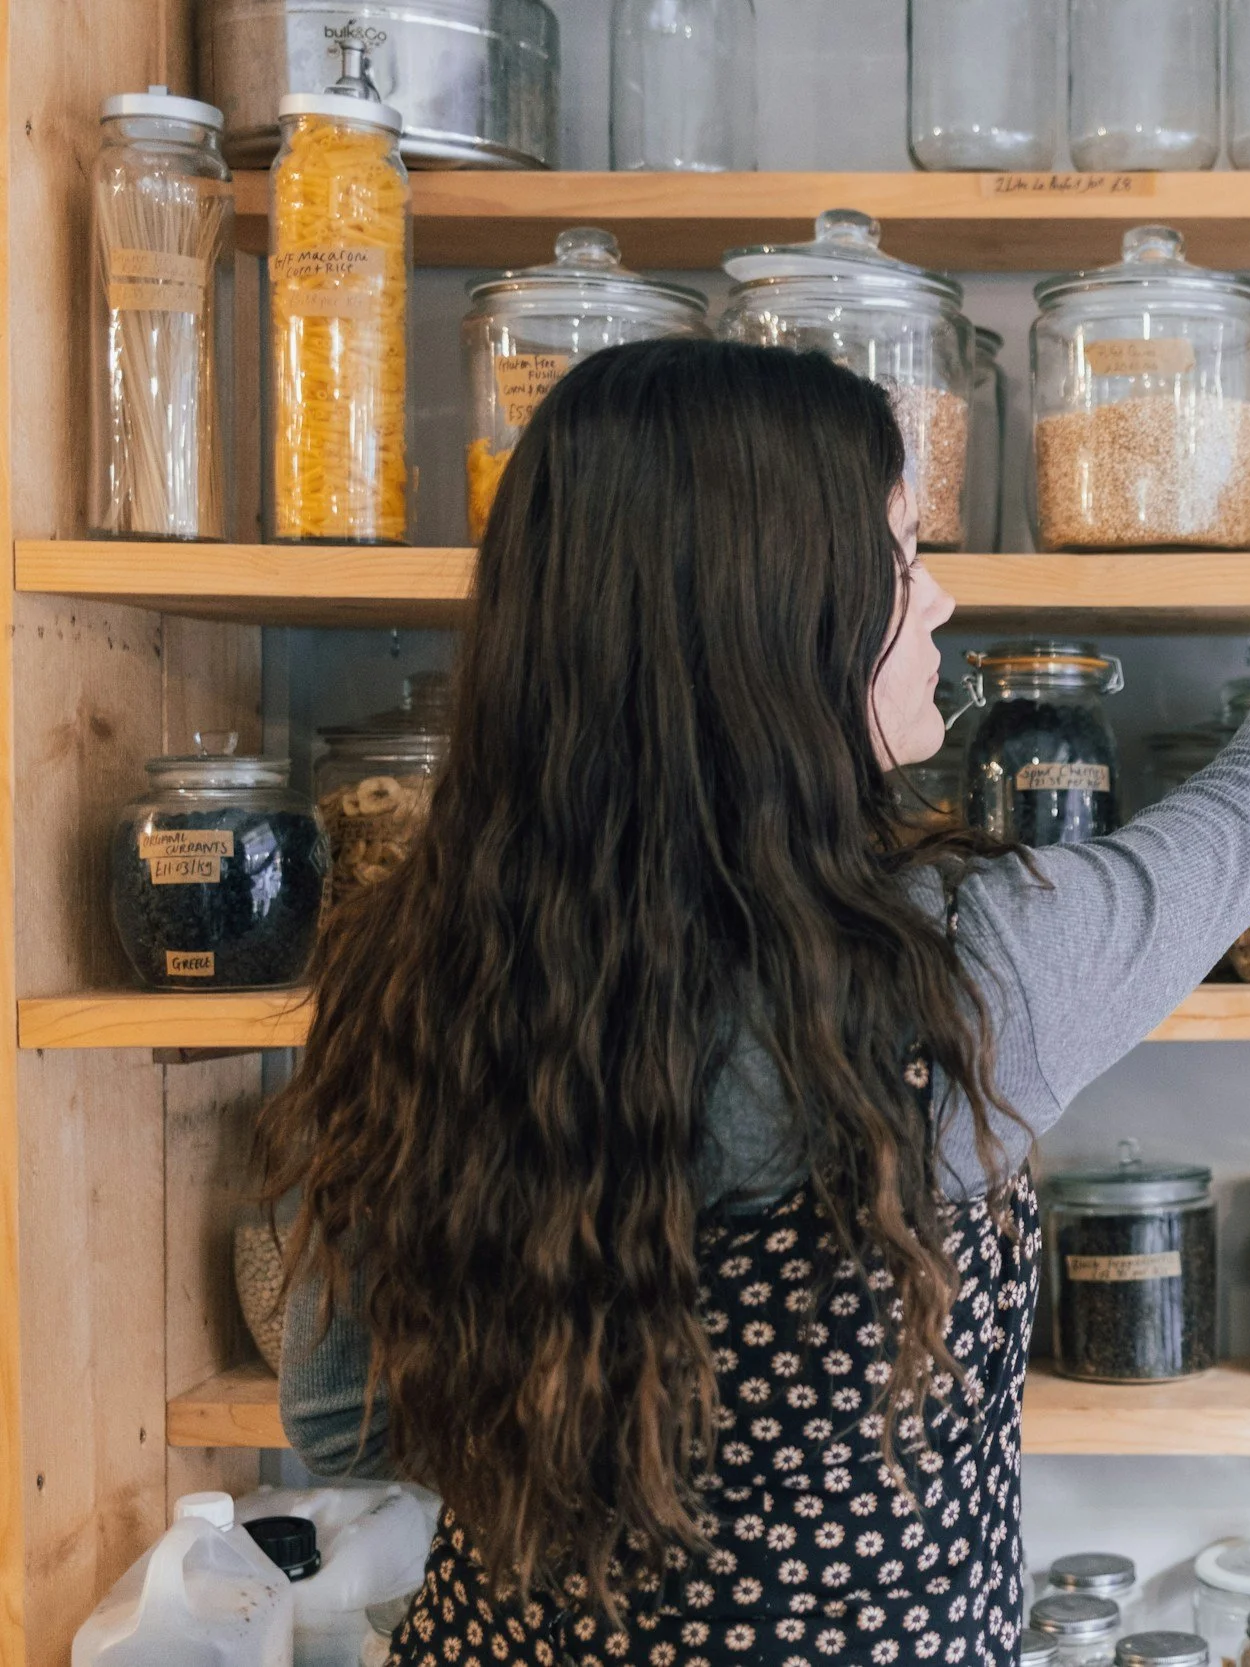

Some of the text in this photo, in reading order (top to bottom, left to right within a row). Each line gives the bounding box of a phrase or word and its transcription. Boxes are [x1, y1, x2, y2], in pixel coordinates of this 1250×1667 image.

[324, 22, 387, 41] bulk&Co
[165, 842, 228, 855] CURRANTS
[171, 956, 211, 971] GREECE
